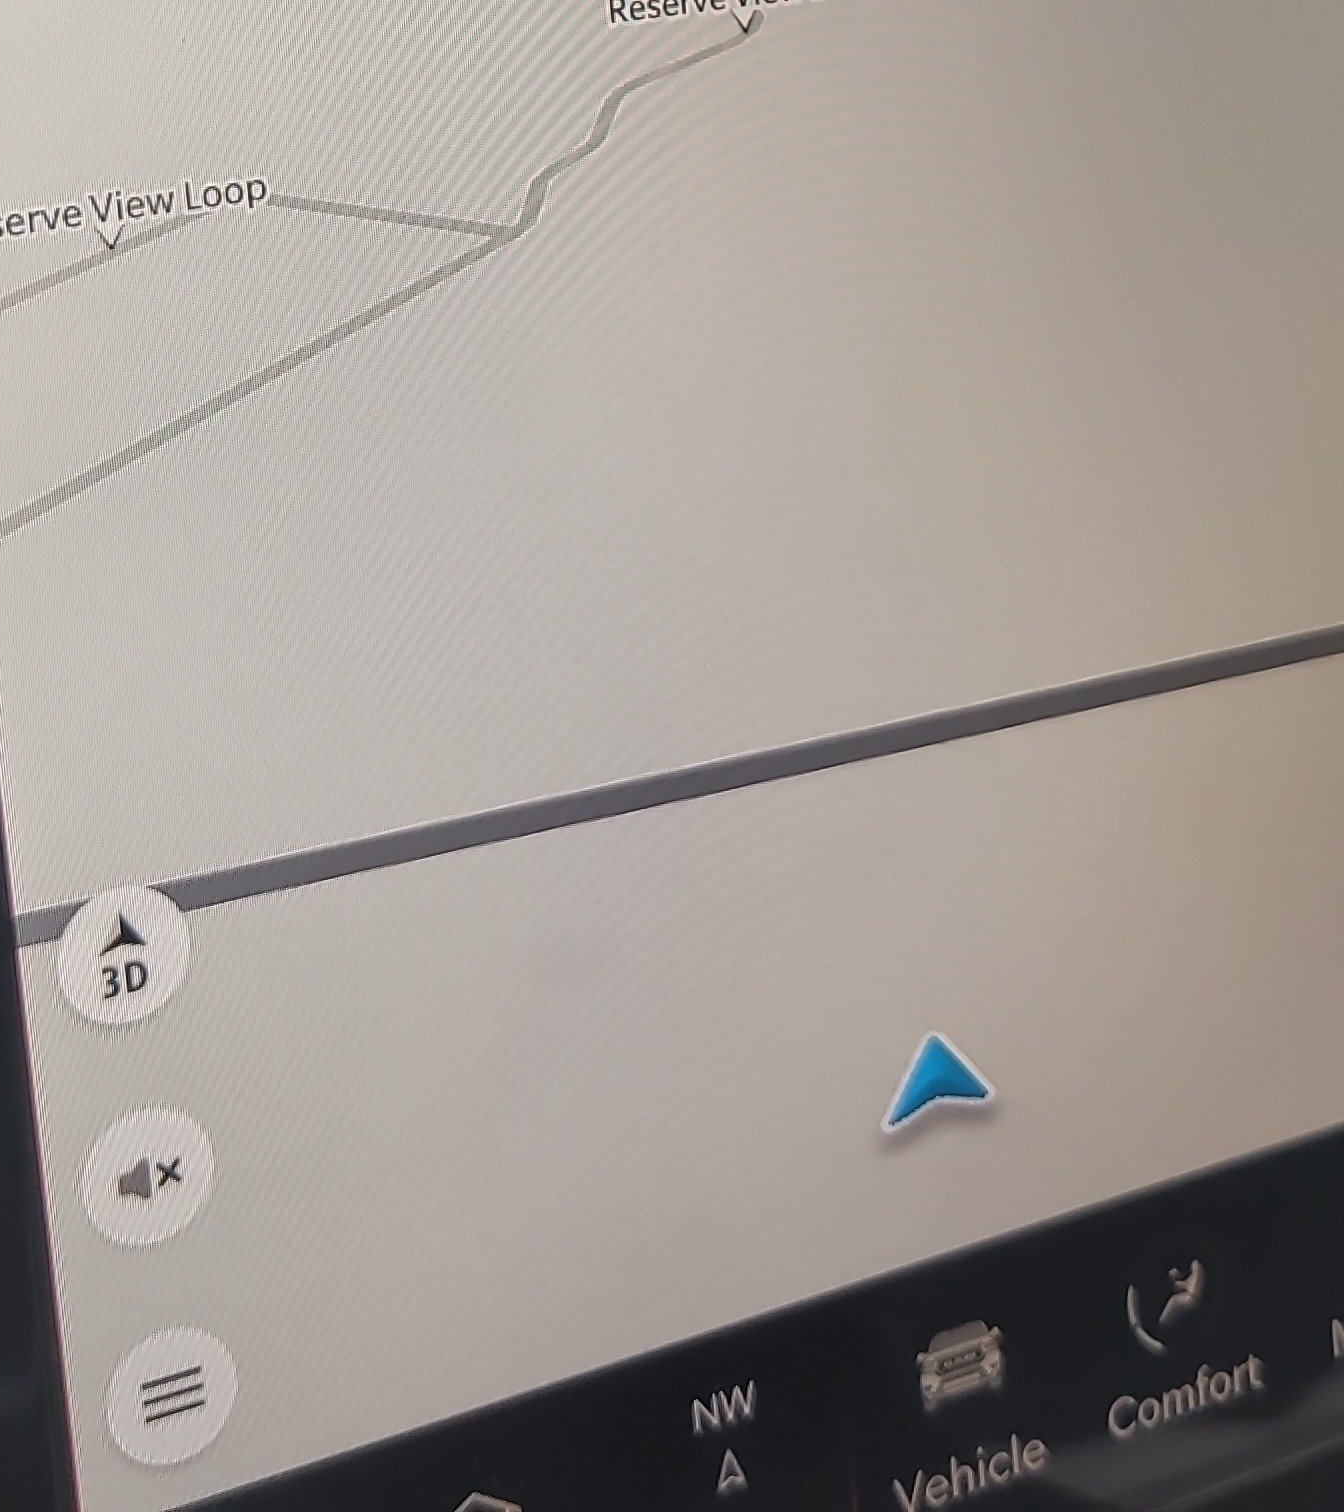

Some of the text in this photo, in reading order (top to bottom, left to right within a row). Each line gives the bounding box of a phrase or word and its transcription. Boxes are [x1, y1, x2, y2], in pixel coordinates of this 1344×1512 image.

[88, 187, 176, 224] View
[184, 175, 268, 214] Loop
[101, 959, 149, 1000] 3D
[691, 1378, 758, 1435] NW
[1105, 1351, 1263, 1441] Comfort
[892, 1430, 1050, 1512] Vehicle
